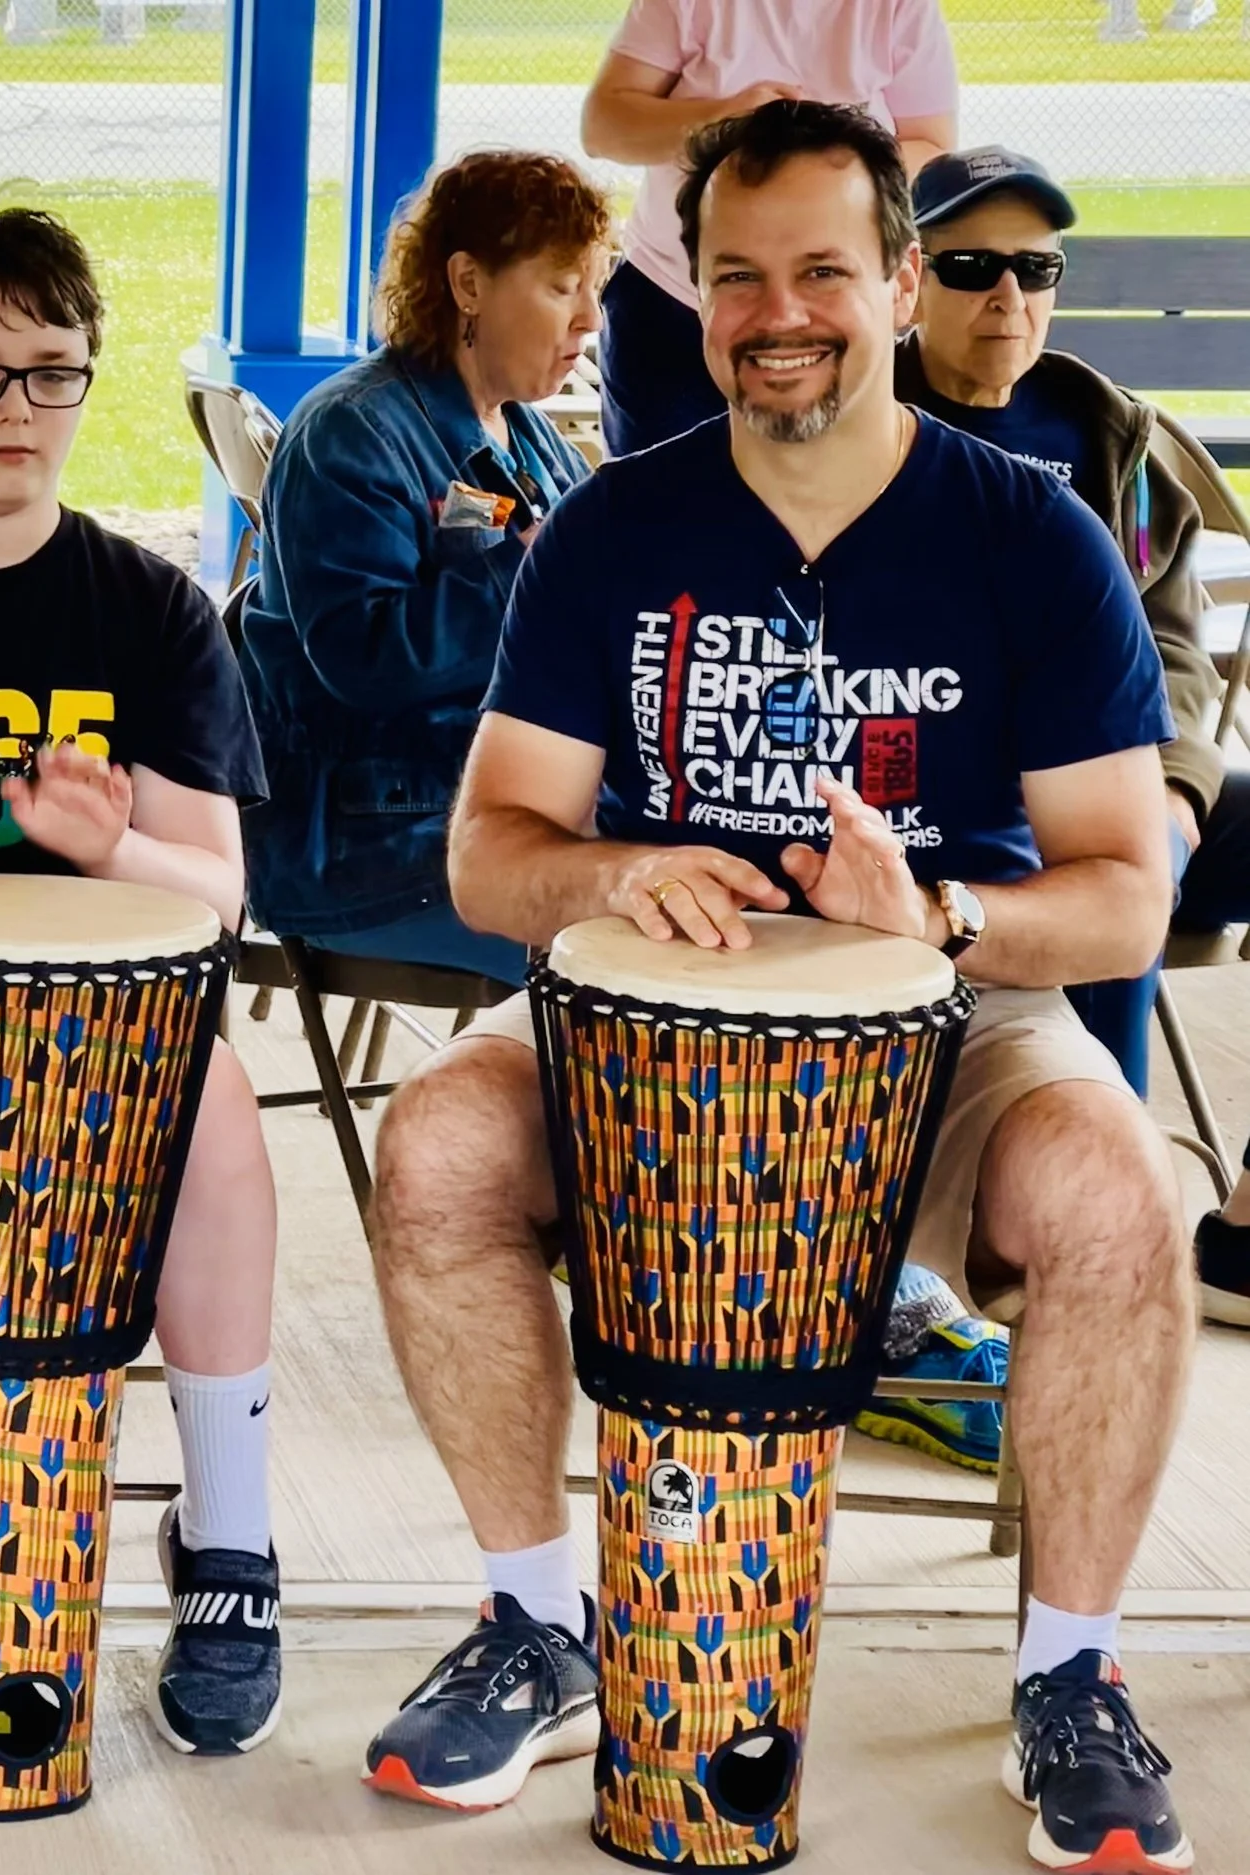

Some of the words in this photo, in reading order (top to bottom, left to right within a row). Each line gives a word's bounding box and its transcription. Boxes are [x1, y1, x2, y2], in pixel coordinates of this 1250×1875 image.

[693, 614, 840, 666] STILL
[686, 661, 963, 716] BREAKING
[682, 709, 860, 763] EVERY
[683, 758, 855, 809] CHAIN
[648, 1510, 693, 1530] TOCA
